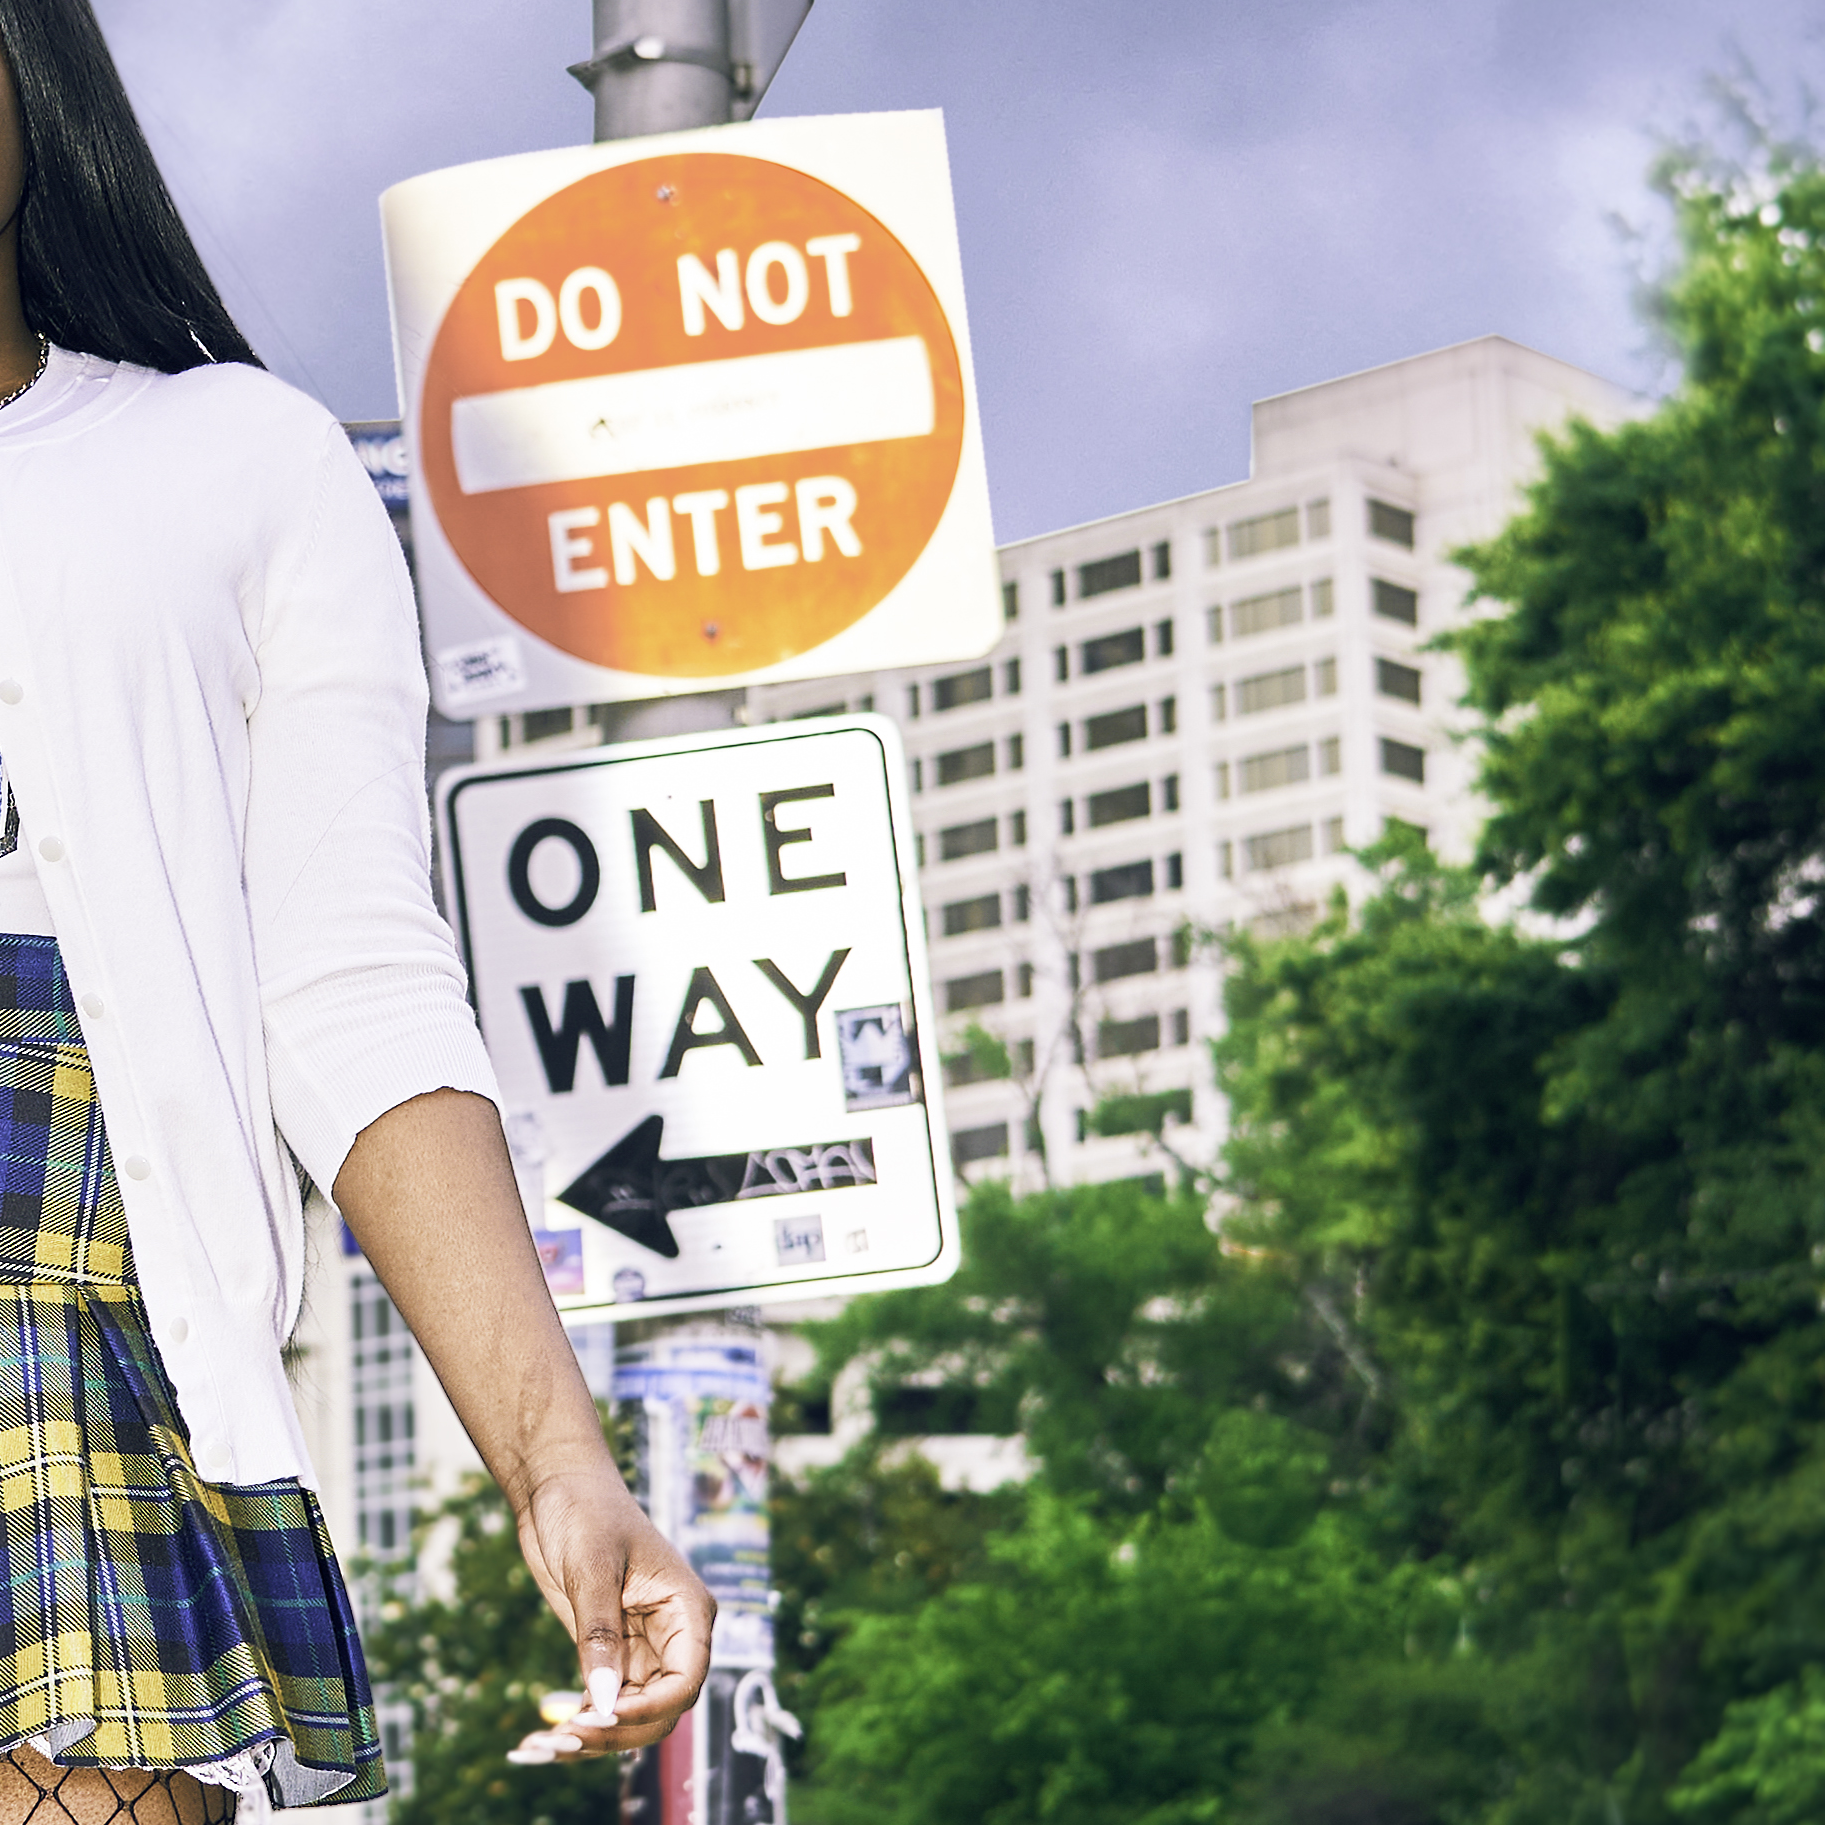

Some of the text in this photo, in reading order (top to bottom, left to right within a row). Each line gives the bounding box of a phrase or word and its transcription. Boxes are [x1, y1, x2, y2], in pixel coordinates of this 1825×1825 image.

[493, 232, 862, 362] DO NOT
[546, 474, 863, 594] ENTER
[508, 783, 847, 927] ONE
[519, 946, 853, 1095] WAY
